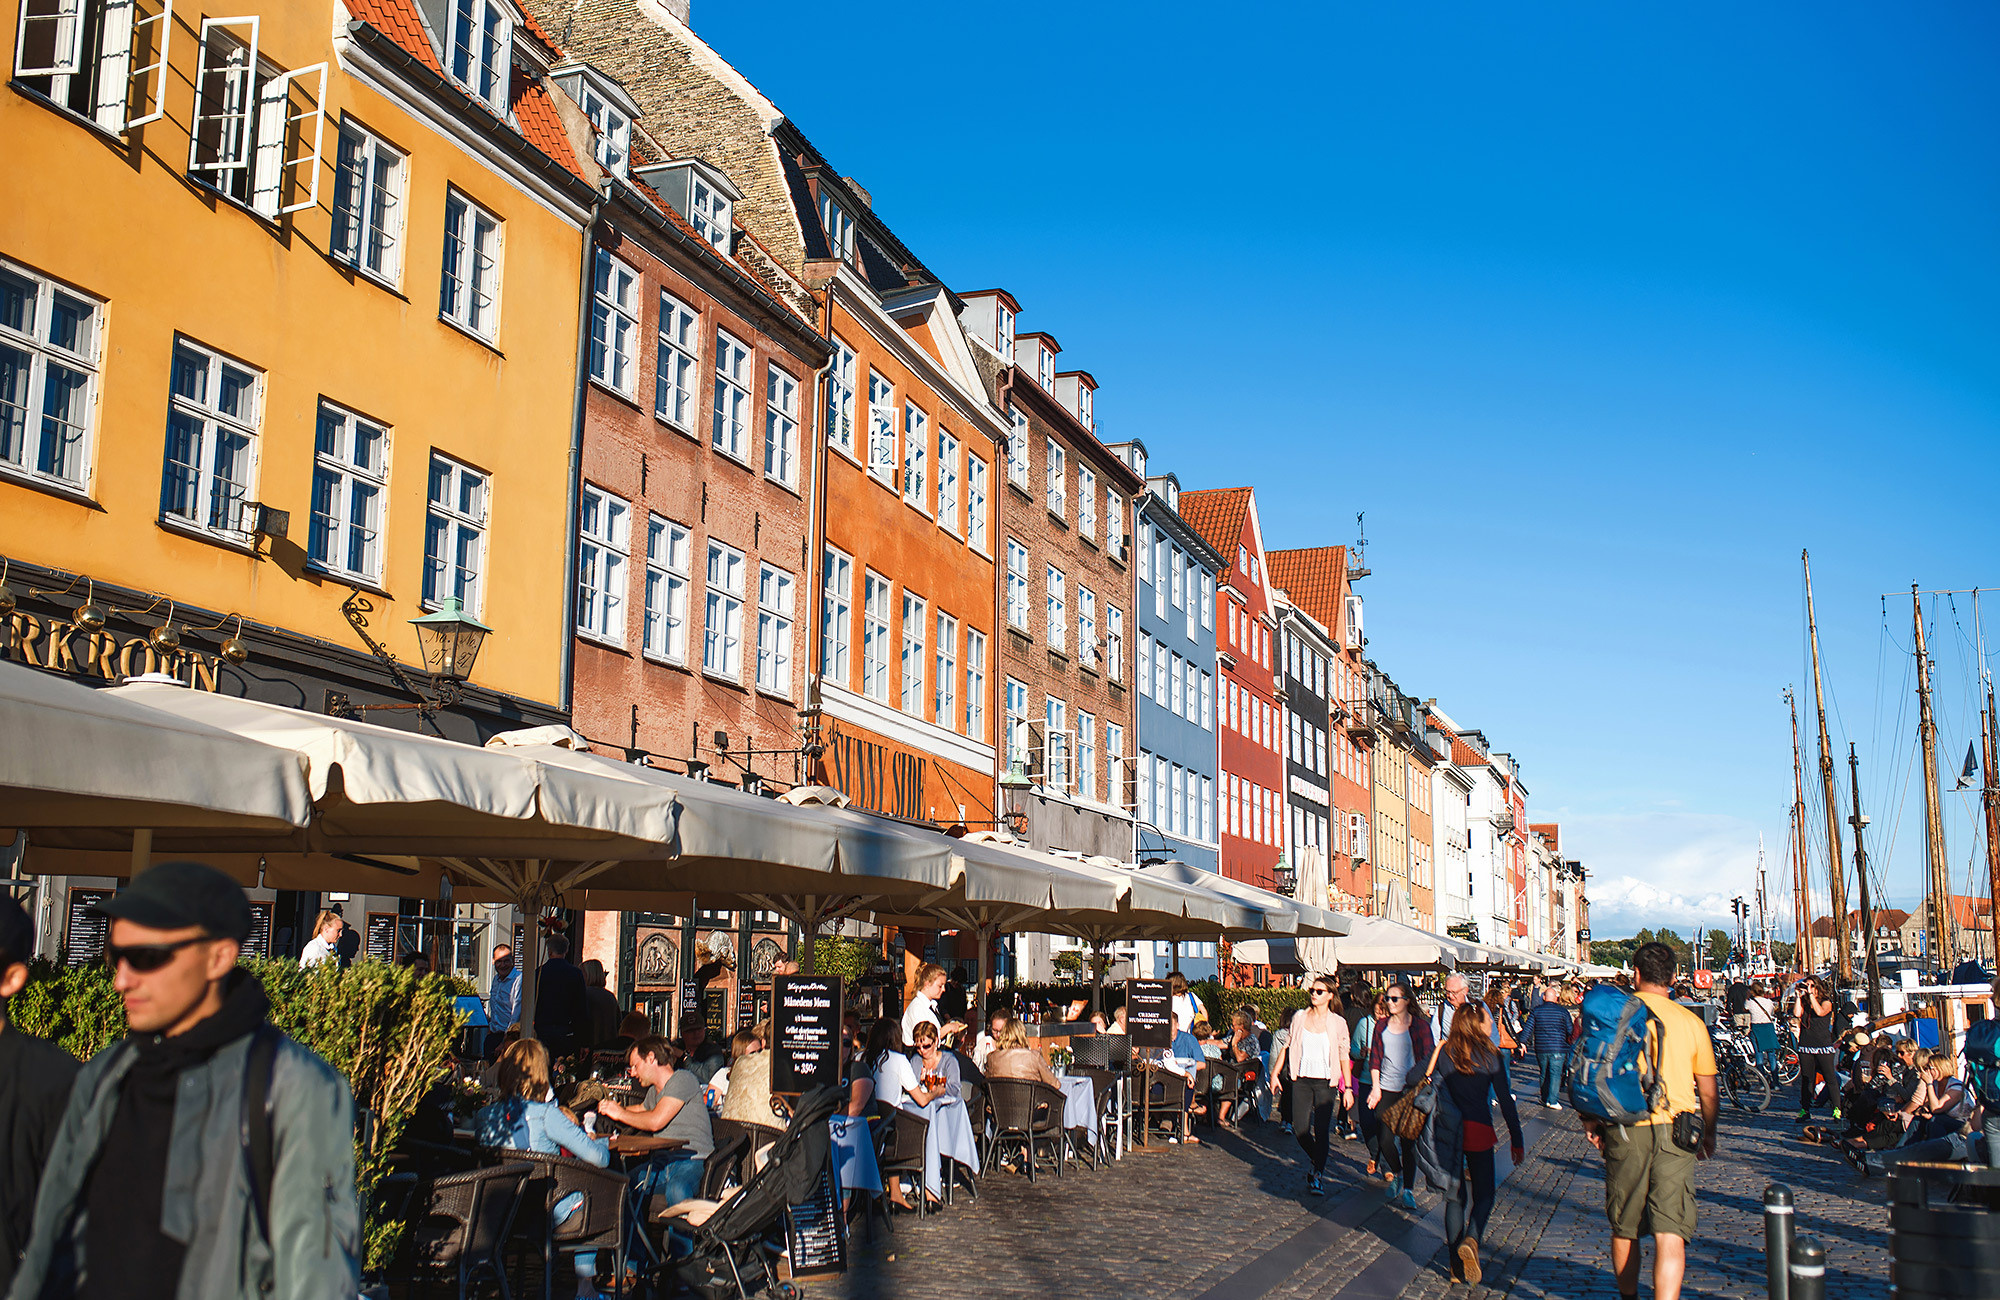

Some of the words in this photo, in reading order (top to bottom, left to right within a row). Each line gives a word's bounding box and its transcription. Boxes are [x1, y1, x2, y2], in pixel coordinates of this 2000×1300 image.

[428, 648, 449, 666] 27
[456, 651, 473, 668] 27
[833, 733, 889, 813] SUNNY
[891, 751, 927, 822] SIDE
[684, 988, 696, 998] Irish
[683, 998, 698, 1009] Coffee
[813, 996, 831, 1008] Menu
